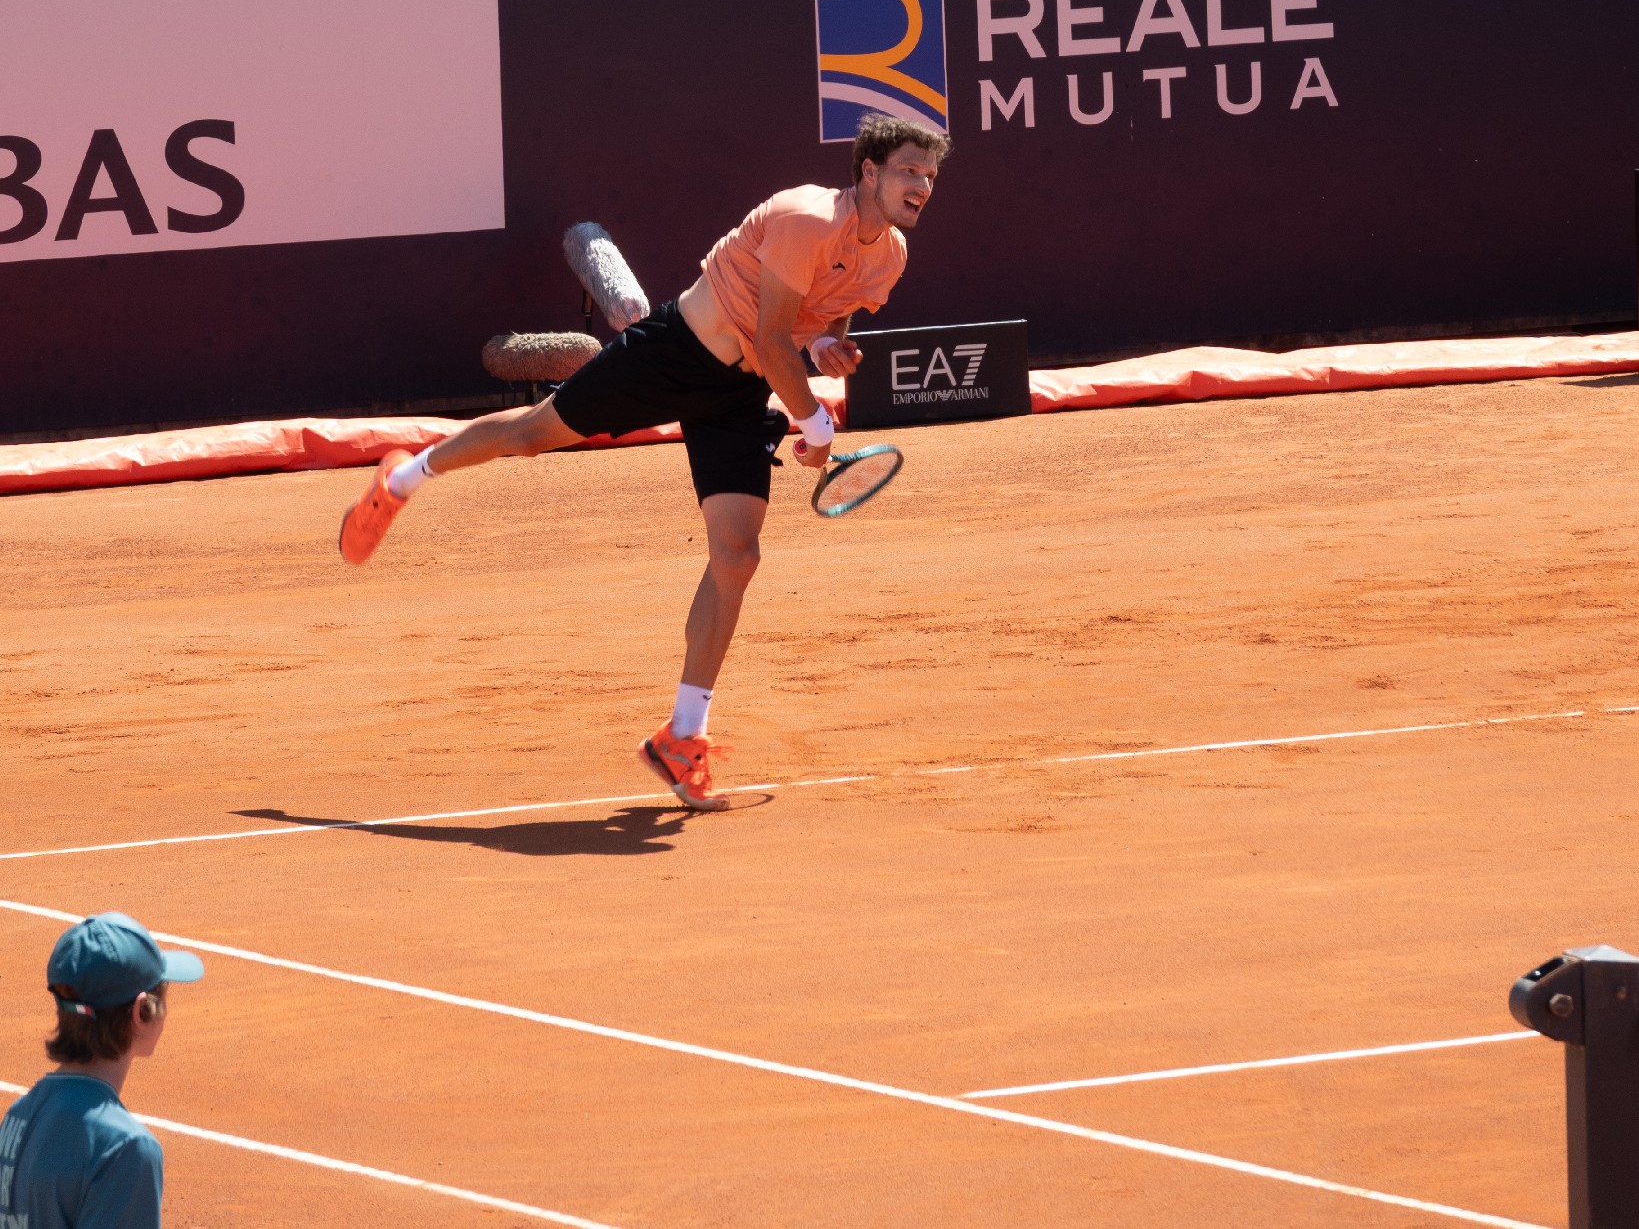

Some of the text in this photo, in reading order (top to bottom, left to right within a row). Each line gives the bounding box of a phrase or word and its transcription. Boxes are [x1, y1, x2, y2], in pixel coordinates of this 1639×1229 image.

[978, 57, 1339, 131] MUTUA
[0, 119, 245, 245] BAS
[891, 343, 988, 390] EA7
[892, 387, 989, 405] EMPORIO ARMANI
